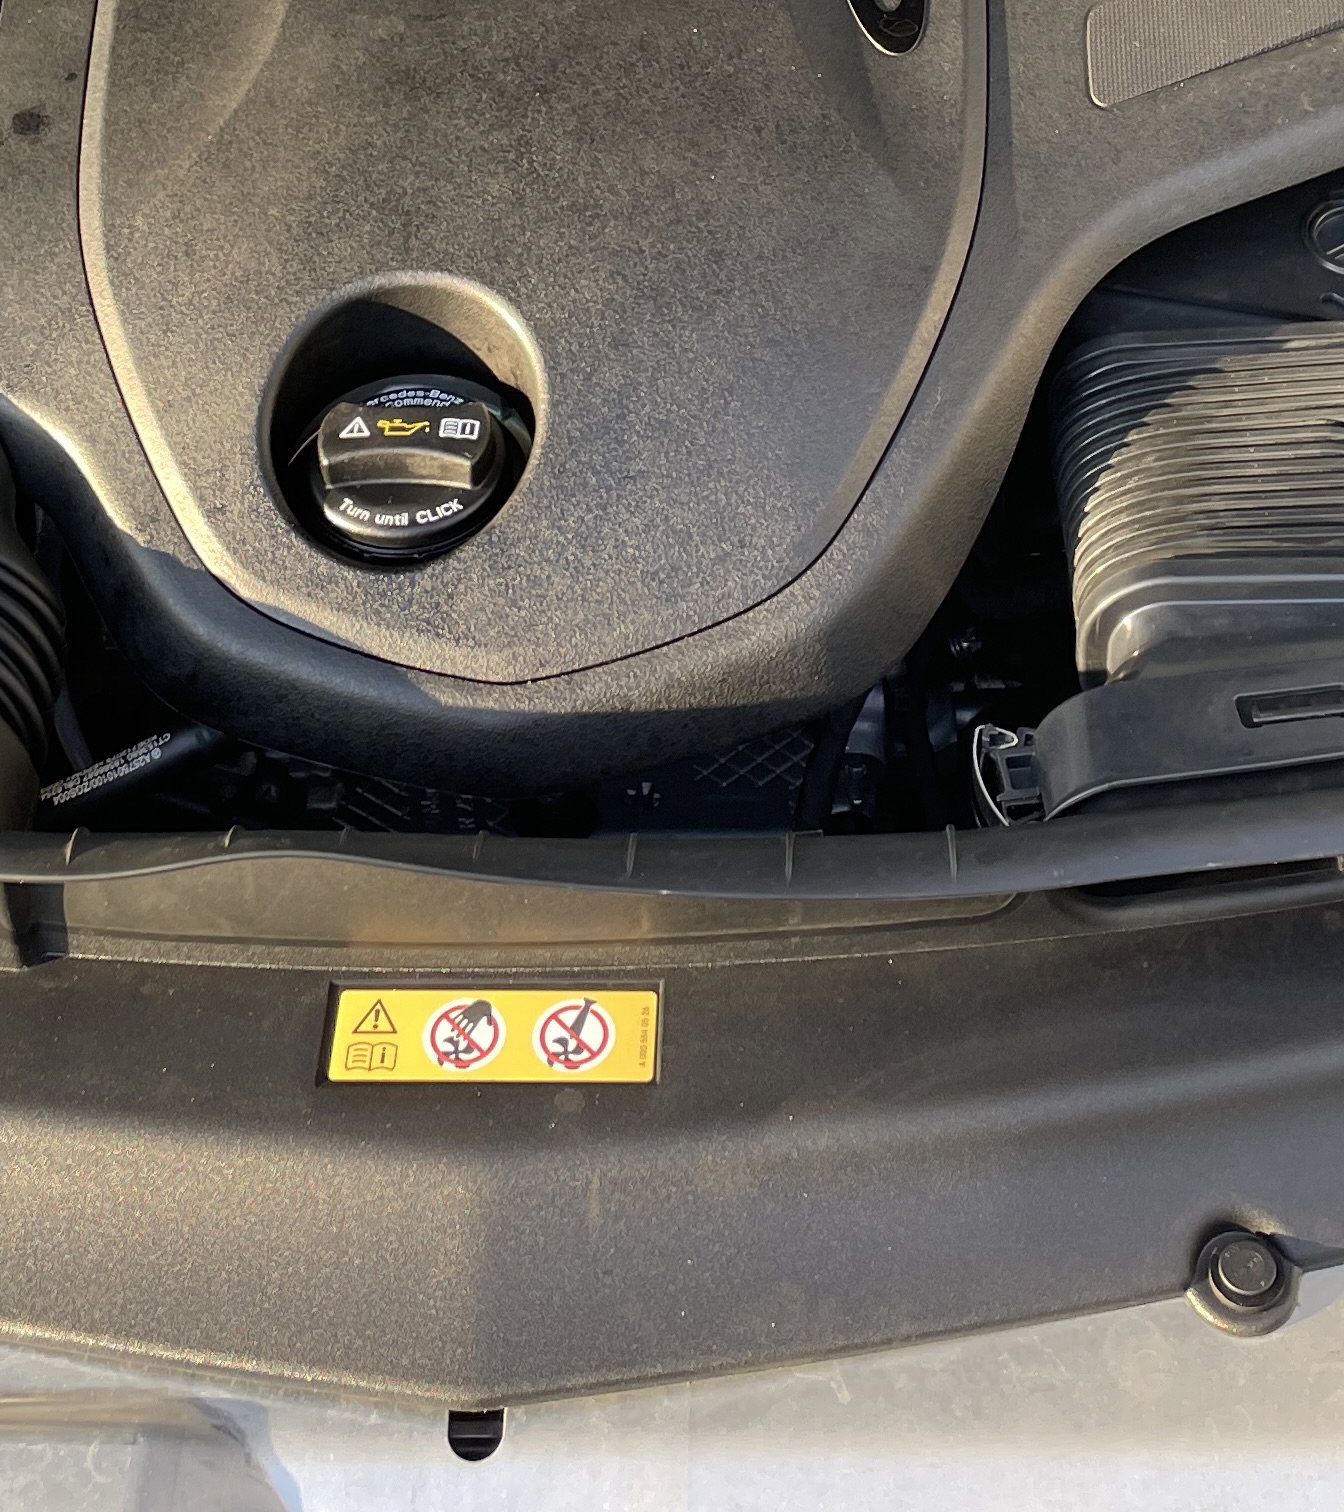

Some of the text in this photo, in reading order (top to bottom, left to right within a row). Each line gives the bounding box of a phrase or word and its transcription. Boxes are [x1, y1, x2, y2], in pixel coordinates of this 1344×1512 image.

[366, 389, 465, 407] ercedes-Benz
[338, 497, 464, 527] Turn until CLICK
